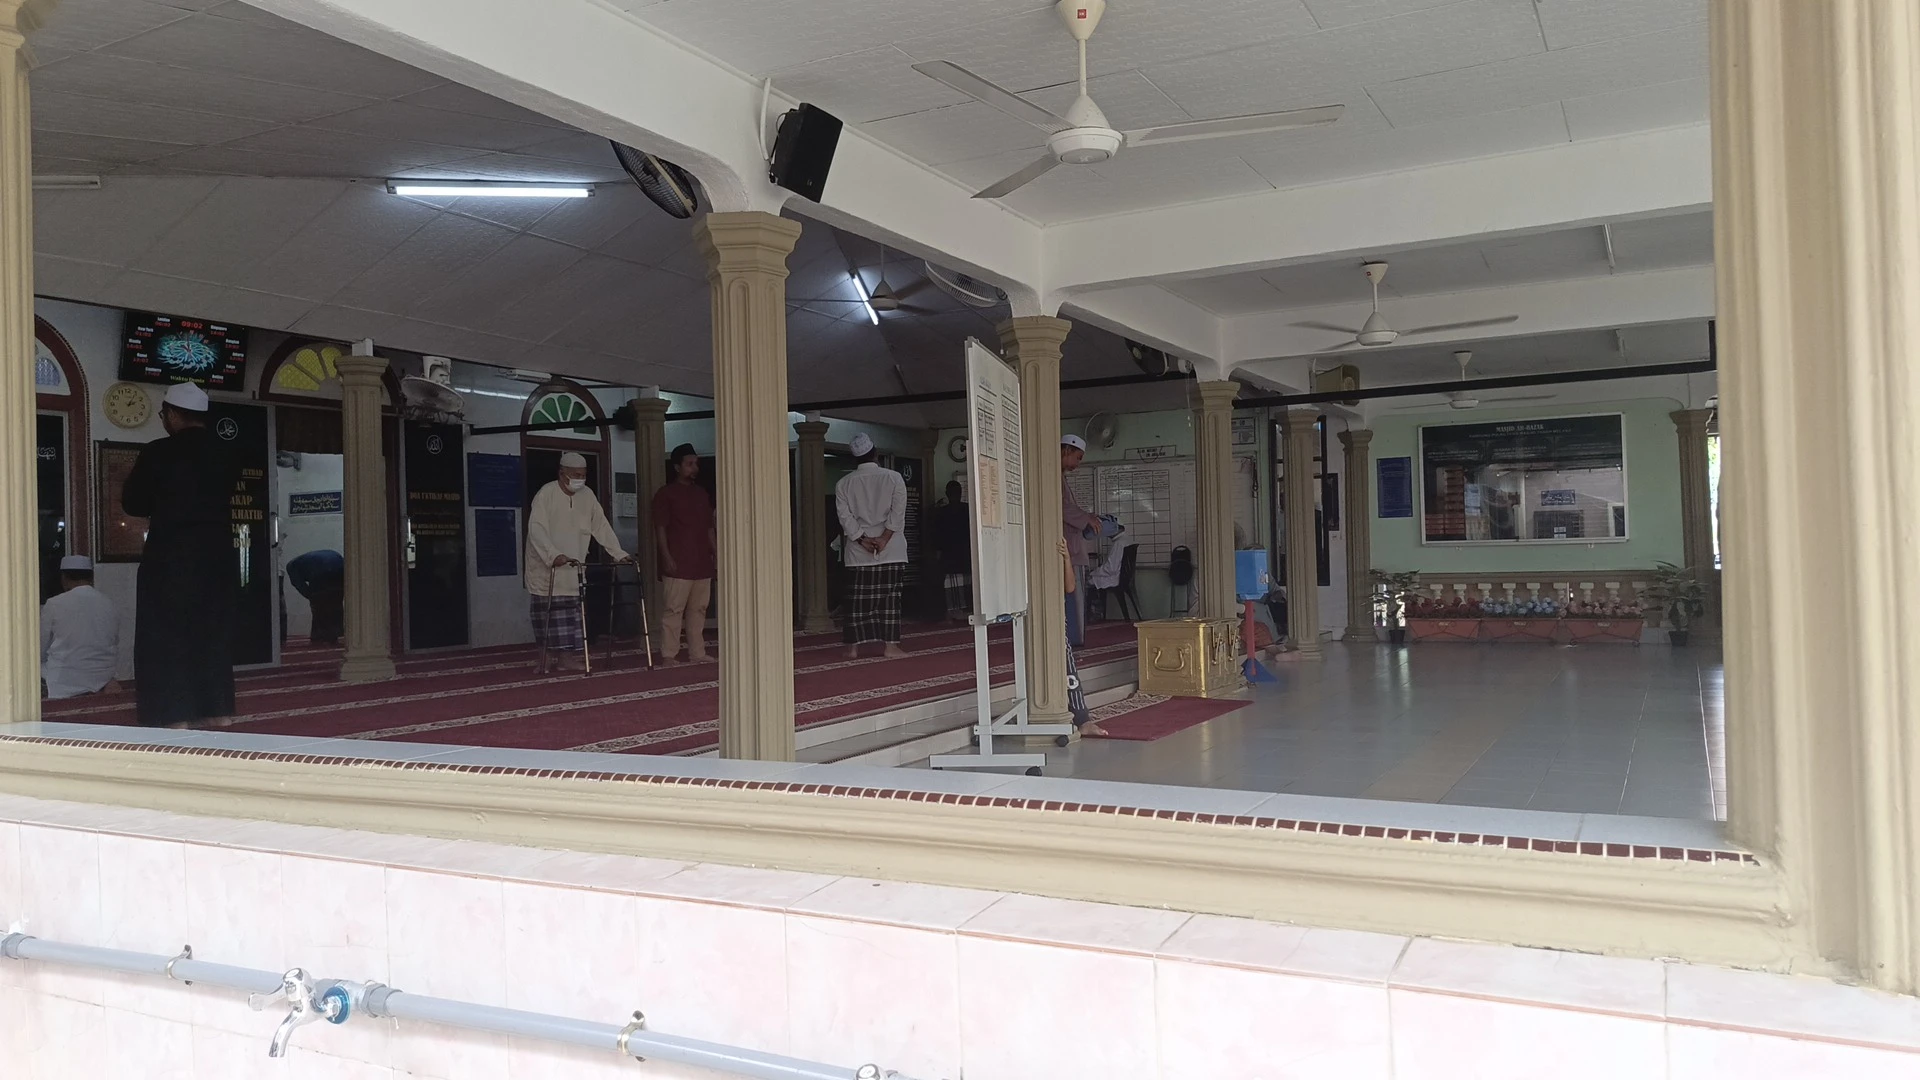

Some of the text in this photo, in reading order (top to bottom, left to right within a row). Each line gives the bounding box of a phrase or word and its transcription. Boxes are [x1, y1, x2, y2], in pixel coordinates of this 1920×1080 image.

[181, 320, 203, 329] 09:02
[1496, 425, 1516, 433] MASJID
[231, 509, 263, 520] KHATIB
